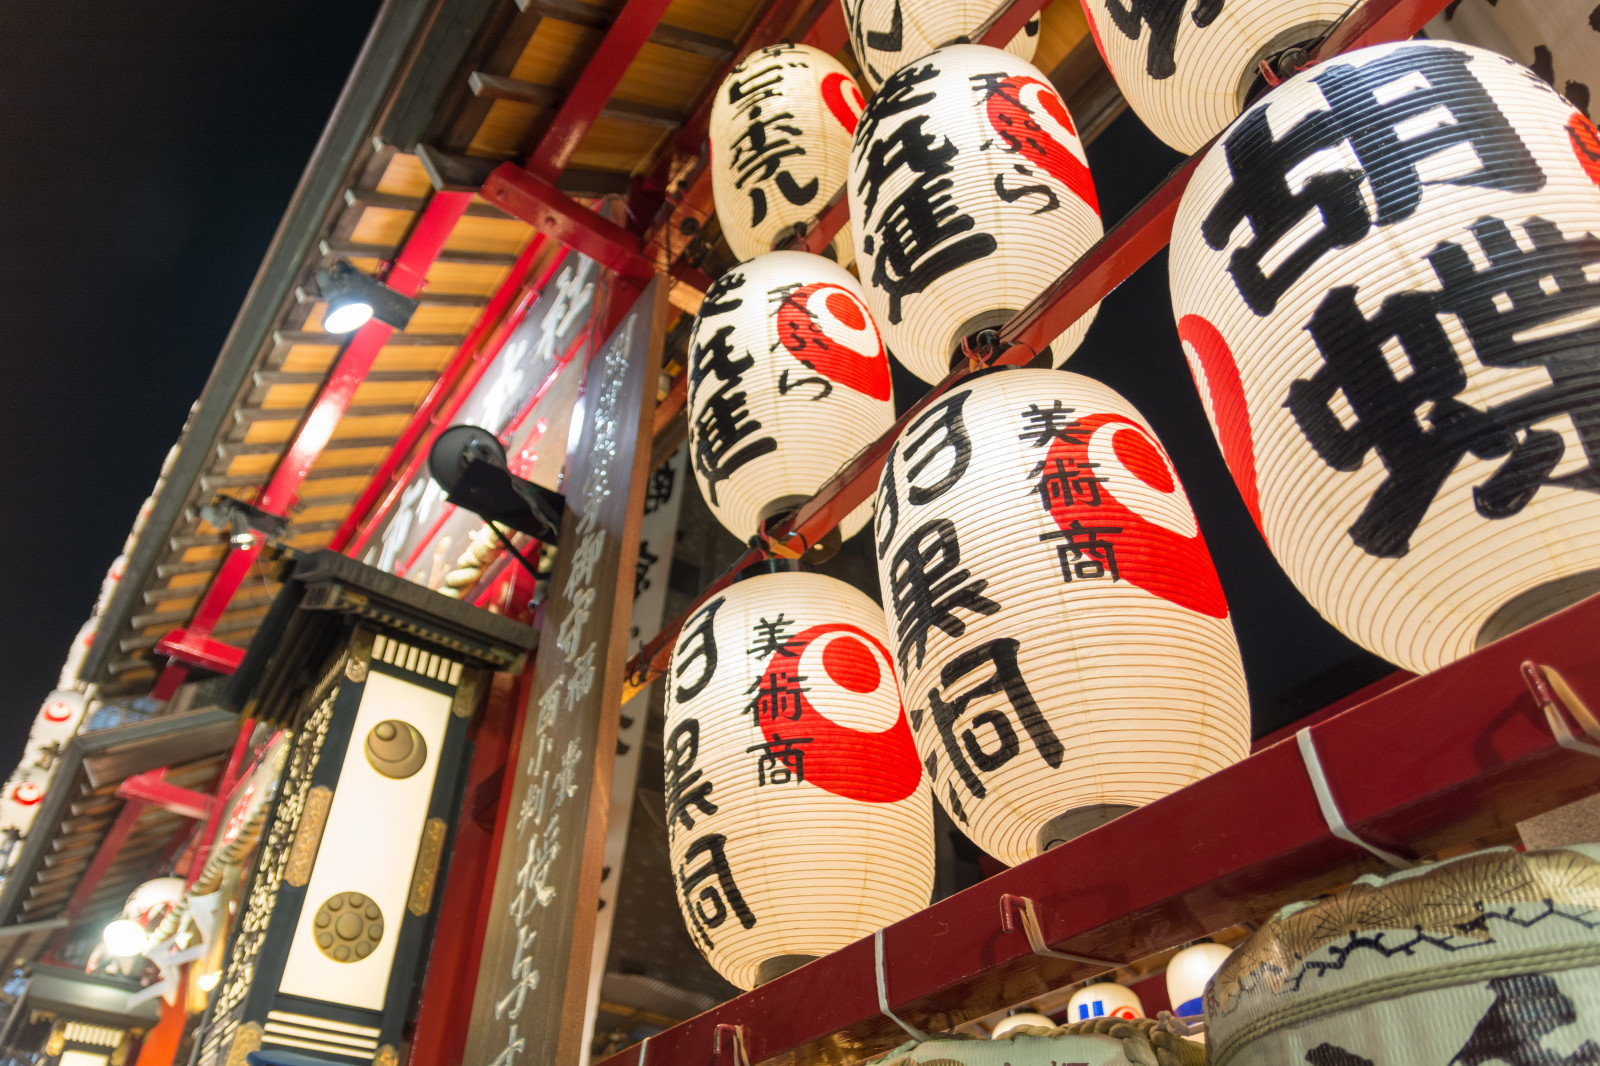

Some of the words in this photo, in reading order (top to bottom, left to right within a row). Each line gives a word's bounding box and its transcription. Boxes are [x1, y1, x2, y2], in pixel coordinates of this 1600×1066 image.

[969, 72, 1061, 215] 天ぷら
[767, 282, 833, 400] 天ぷら
[1018, 399, 1123, 584] 美術商
[742, 612, 814, 787] 美術商
